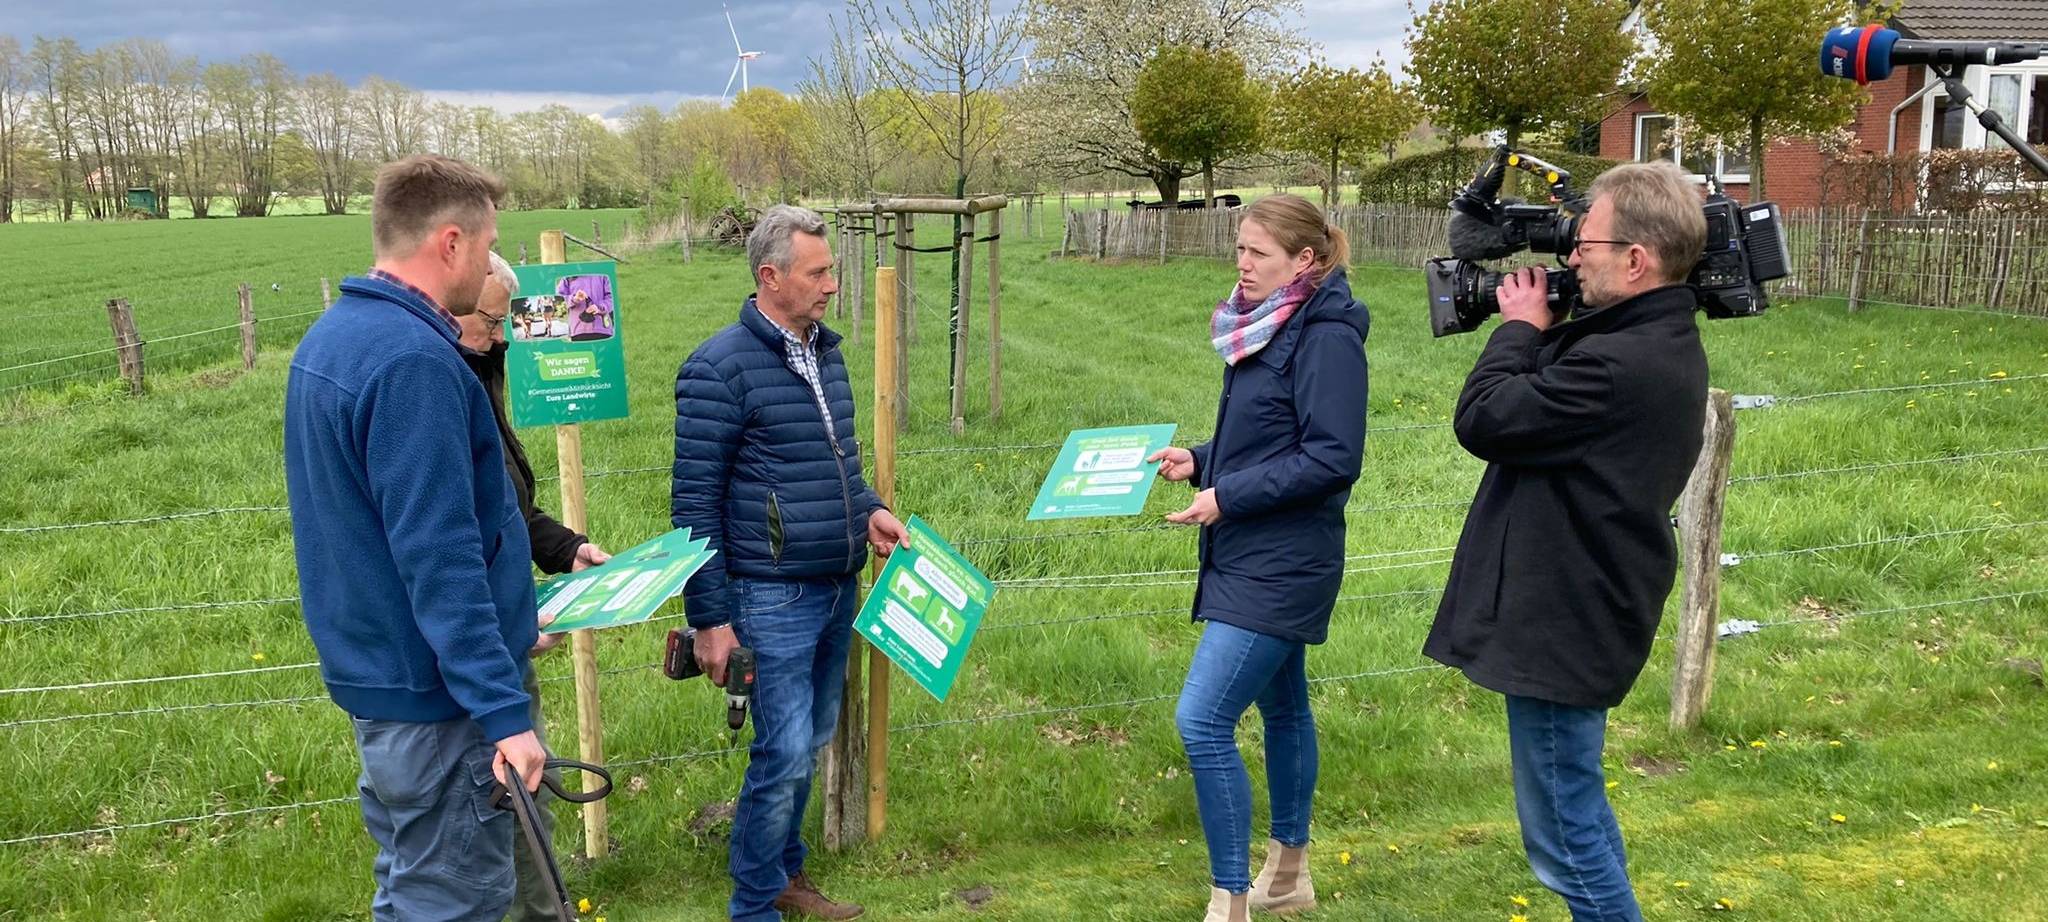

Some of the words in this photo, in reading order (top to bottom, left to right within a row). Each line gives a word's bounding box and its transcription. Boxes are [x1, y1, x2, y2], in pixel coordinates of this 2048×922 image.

[564, 357, 589, 366] sagen
[551, 366, 586, 377] DANKE!
[562, 392, 596, 401] Landwirte
